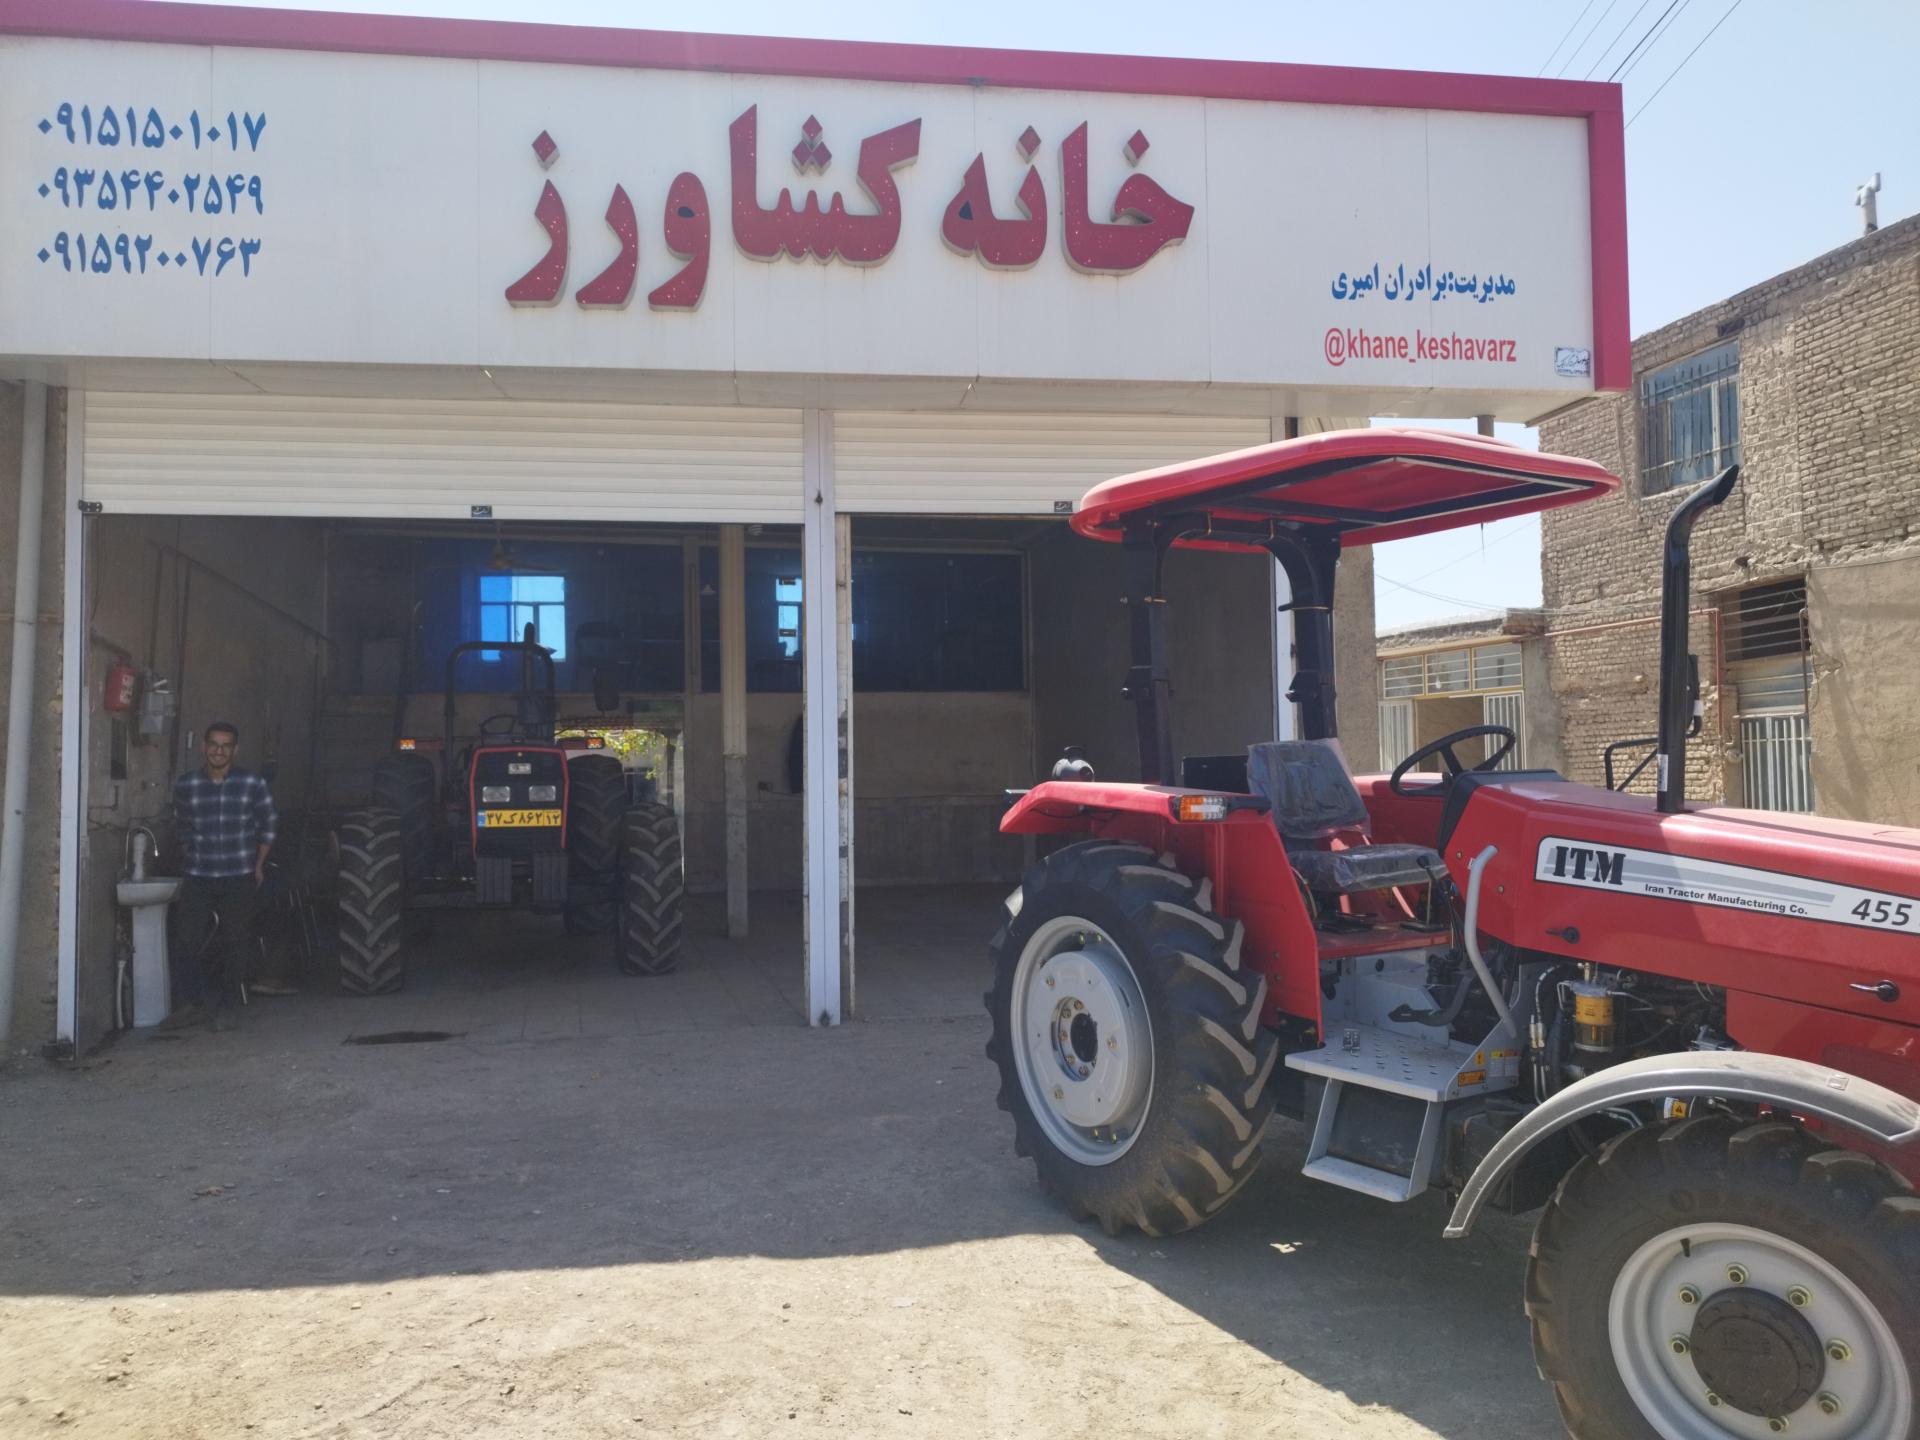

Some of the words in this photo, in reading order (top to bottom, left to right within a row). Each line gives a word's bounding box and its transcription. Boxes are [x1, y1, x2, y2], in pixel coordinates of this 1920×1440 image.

[37, 102, 267, 152] ۰۹۱۵۱۵۰۱۰۱۷
[37, 166, 264, 215] ۰۹۳۵۴۴۰۲۵۴۹
[504, 103, 922, 312] کشاورز
[940, 121, 1195, 276] خانه
[37, 231, 261, 277] ۰۹۱۵۹۲۰۰۷۶۳
[1331, 262, 1380, 301] امیری
[1324, 327, 1517, 367] @khane_keshavarz
[1553, 845, 1626, 885] ITM
[1645, 883, 1664, 894] Iran
[1668, 886, 1705, 900] Tractor
[1708, 892, 1786, 913] Manufacturing
[1789, 904, 1808, 915] Co.
[1851, 898, 1912, 926] 455
